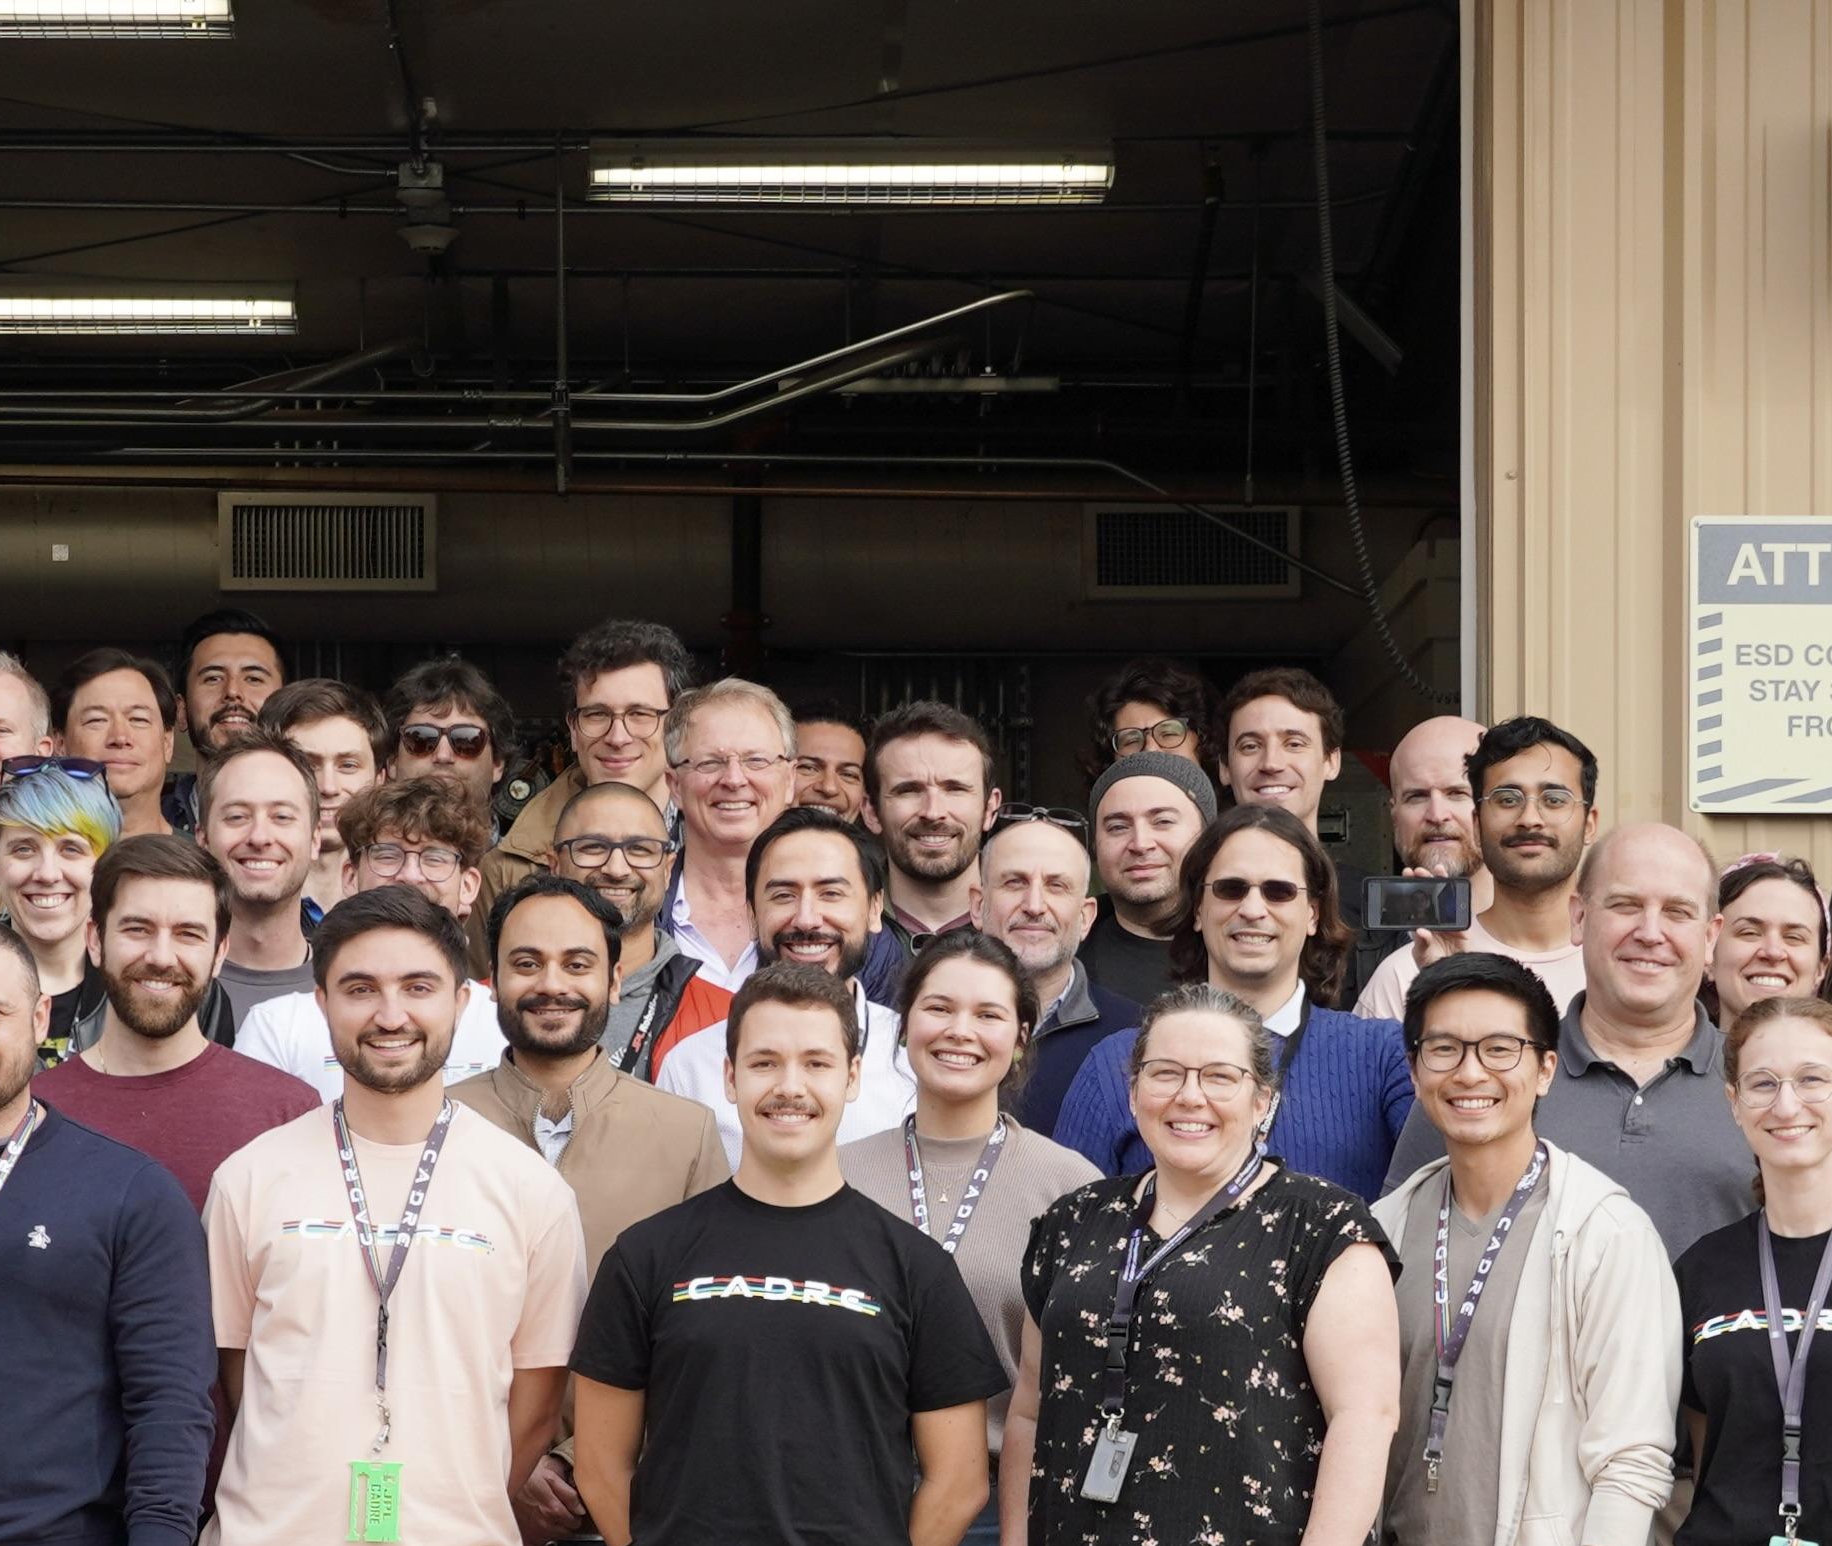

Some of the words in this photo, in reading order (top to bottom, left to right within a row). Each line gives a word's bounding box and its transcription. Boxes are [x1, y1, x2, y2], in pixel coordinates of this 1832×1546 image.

[1735, 644, 1794, 667] ESD
[1749, 680, 1820, 703] STAY
[341, 1148, 374, 1246] CADRE
[396, 1149, 438, 1249] CADRE
[910, 1168, 931, 1235] ADRE
[943, 1168, 989, 1254] CADRE
[688, 1275, 866, 1312] CADRE
[1435, 1207, 1450, 1304] CADRE
[1460, 1216, 1512, 1317] CADRE
[369, 1484, 381, 1525] CADRE
